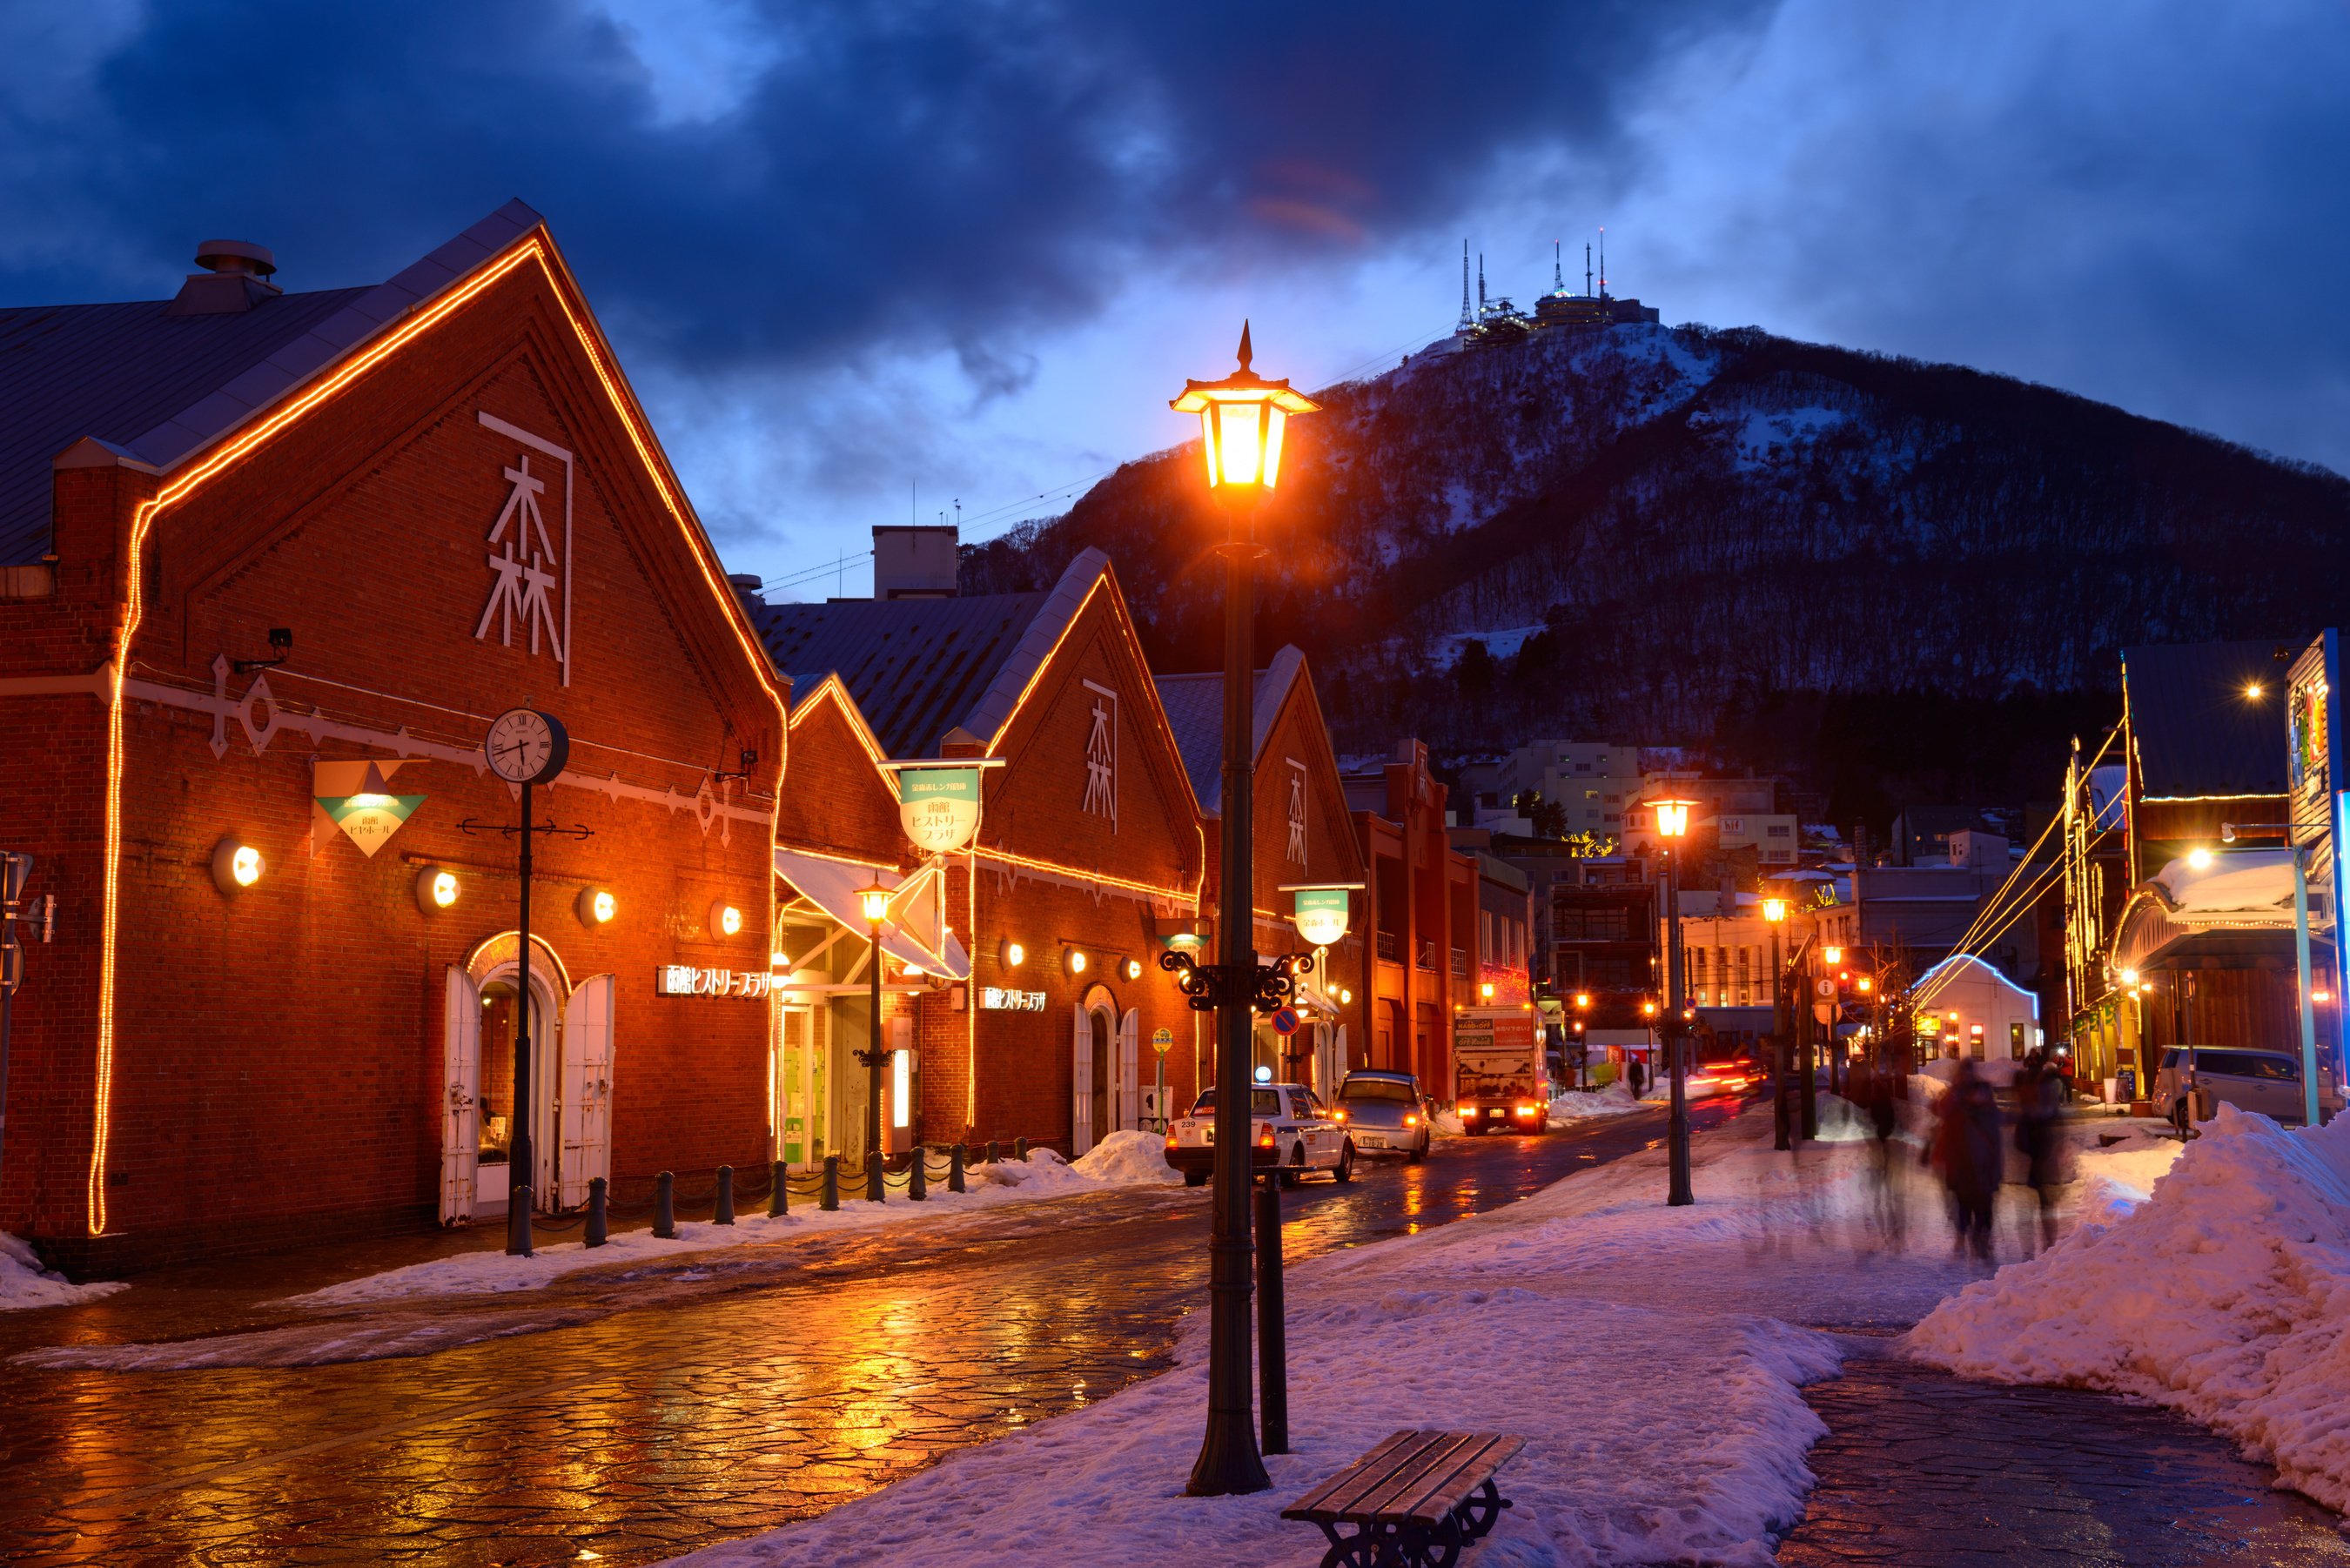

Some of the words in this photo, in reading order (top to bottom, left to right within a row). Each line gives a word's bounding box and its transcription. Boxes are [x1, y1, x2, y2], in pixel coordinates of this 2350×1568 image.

[928, 801, 950, 814] 函館
[912, 815, 966, 828] ヒストリー
